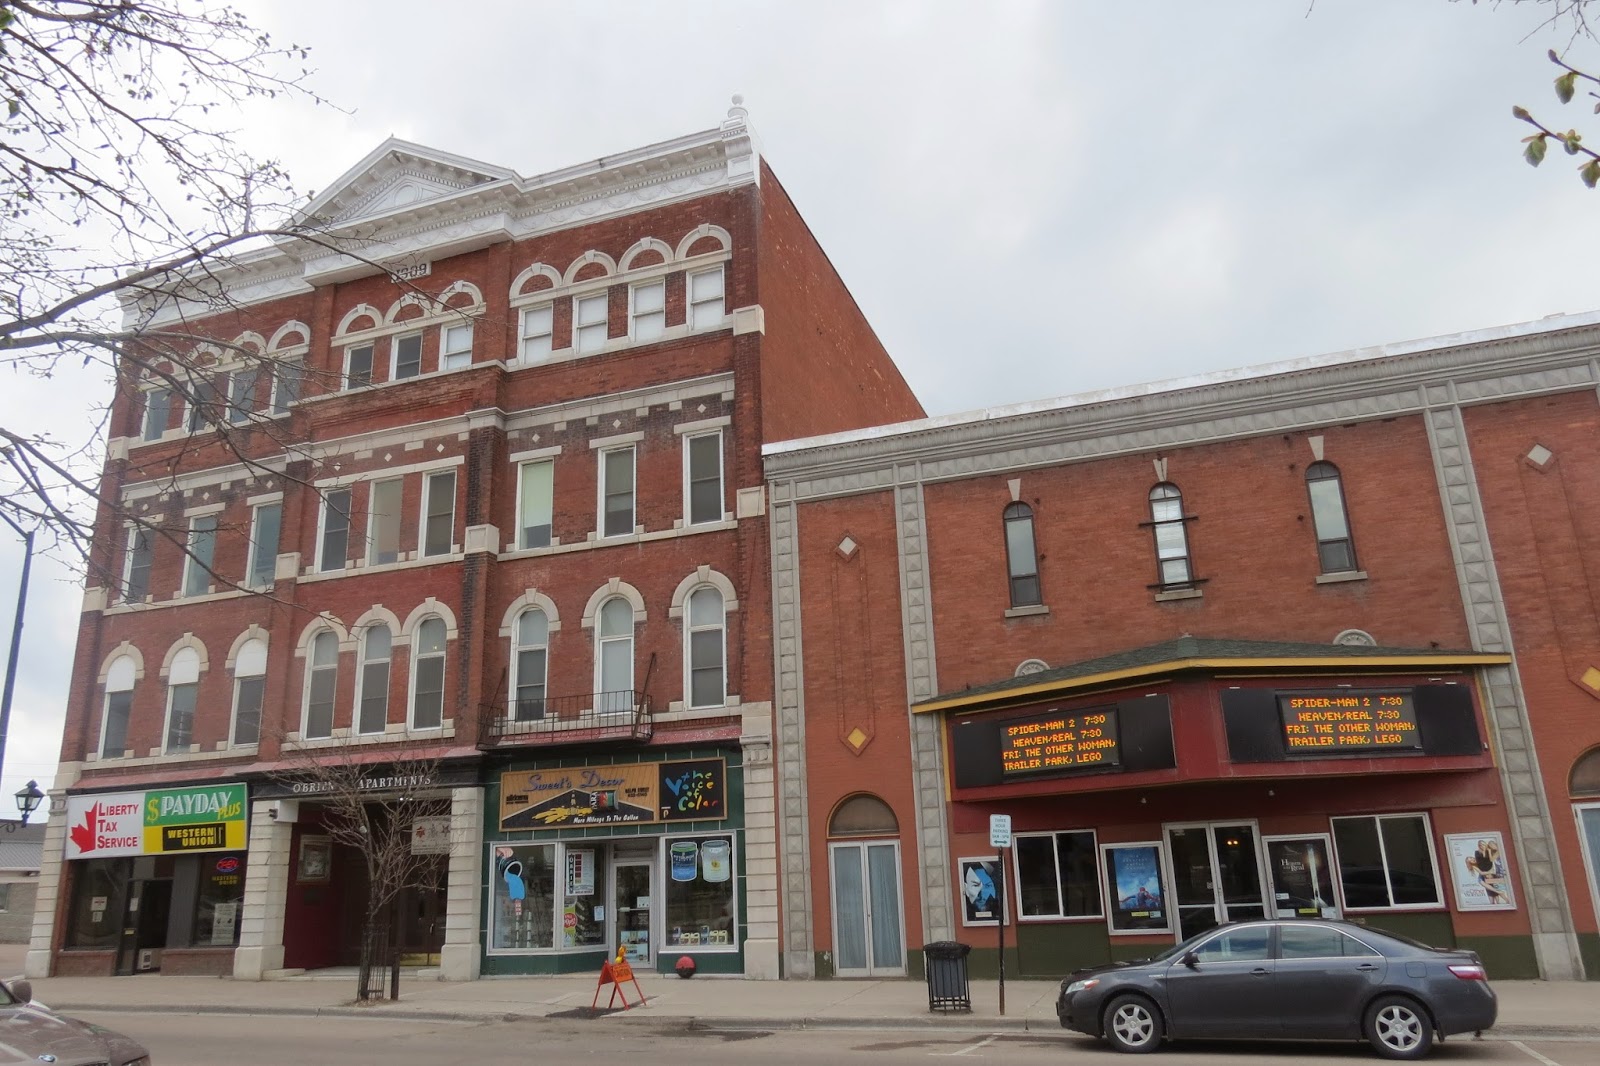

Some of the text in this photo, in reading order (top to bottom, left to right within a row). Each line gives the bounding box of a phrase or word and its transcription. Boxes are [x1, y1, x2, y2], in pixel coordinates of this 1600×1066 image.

[1290, 697, 1403, 708] SPIDER-MAN 2 7:30
[1298, 710, 1400, 721] HEAVEN/REAL 7:30
[1008, 715, 1106, 736] SPIDER-MAN 2 7:30
[1286, 722, 1416, 734] FRI: THE OTHER WOMAN,
[1013, 729, 1102, 748] HEAVEN/REAL 7:30
[1288, 734, 1402, 746] TRAILER PARK, LEGO
[1003, 739, 1116, 760] FRI: THE OTHER WOMAN,
[1004, 752, 1102, 771] TRAILER PARK, LEGO
[523, 770, 625, 792] Sweet's Decor
[681, 770, 713, 782] the
[665, 777, 714, 796] Voice
[686, 788, 700, 799] of
[98, 802, 139, 817] LIBERTY
[160, 791, 232, 817] PAYDAY
[678, 795, 718, 811] Color
[216, 801, 241, 820] PLUS
[97, 820, 117, 833] TAX
[167, 828, 214, 839] WESTERN
[97, 835, 138, 849] SERVICE
[182, 836, 214, 847] UNION
[217, 858, 238, 869] OPEN
